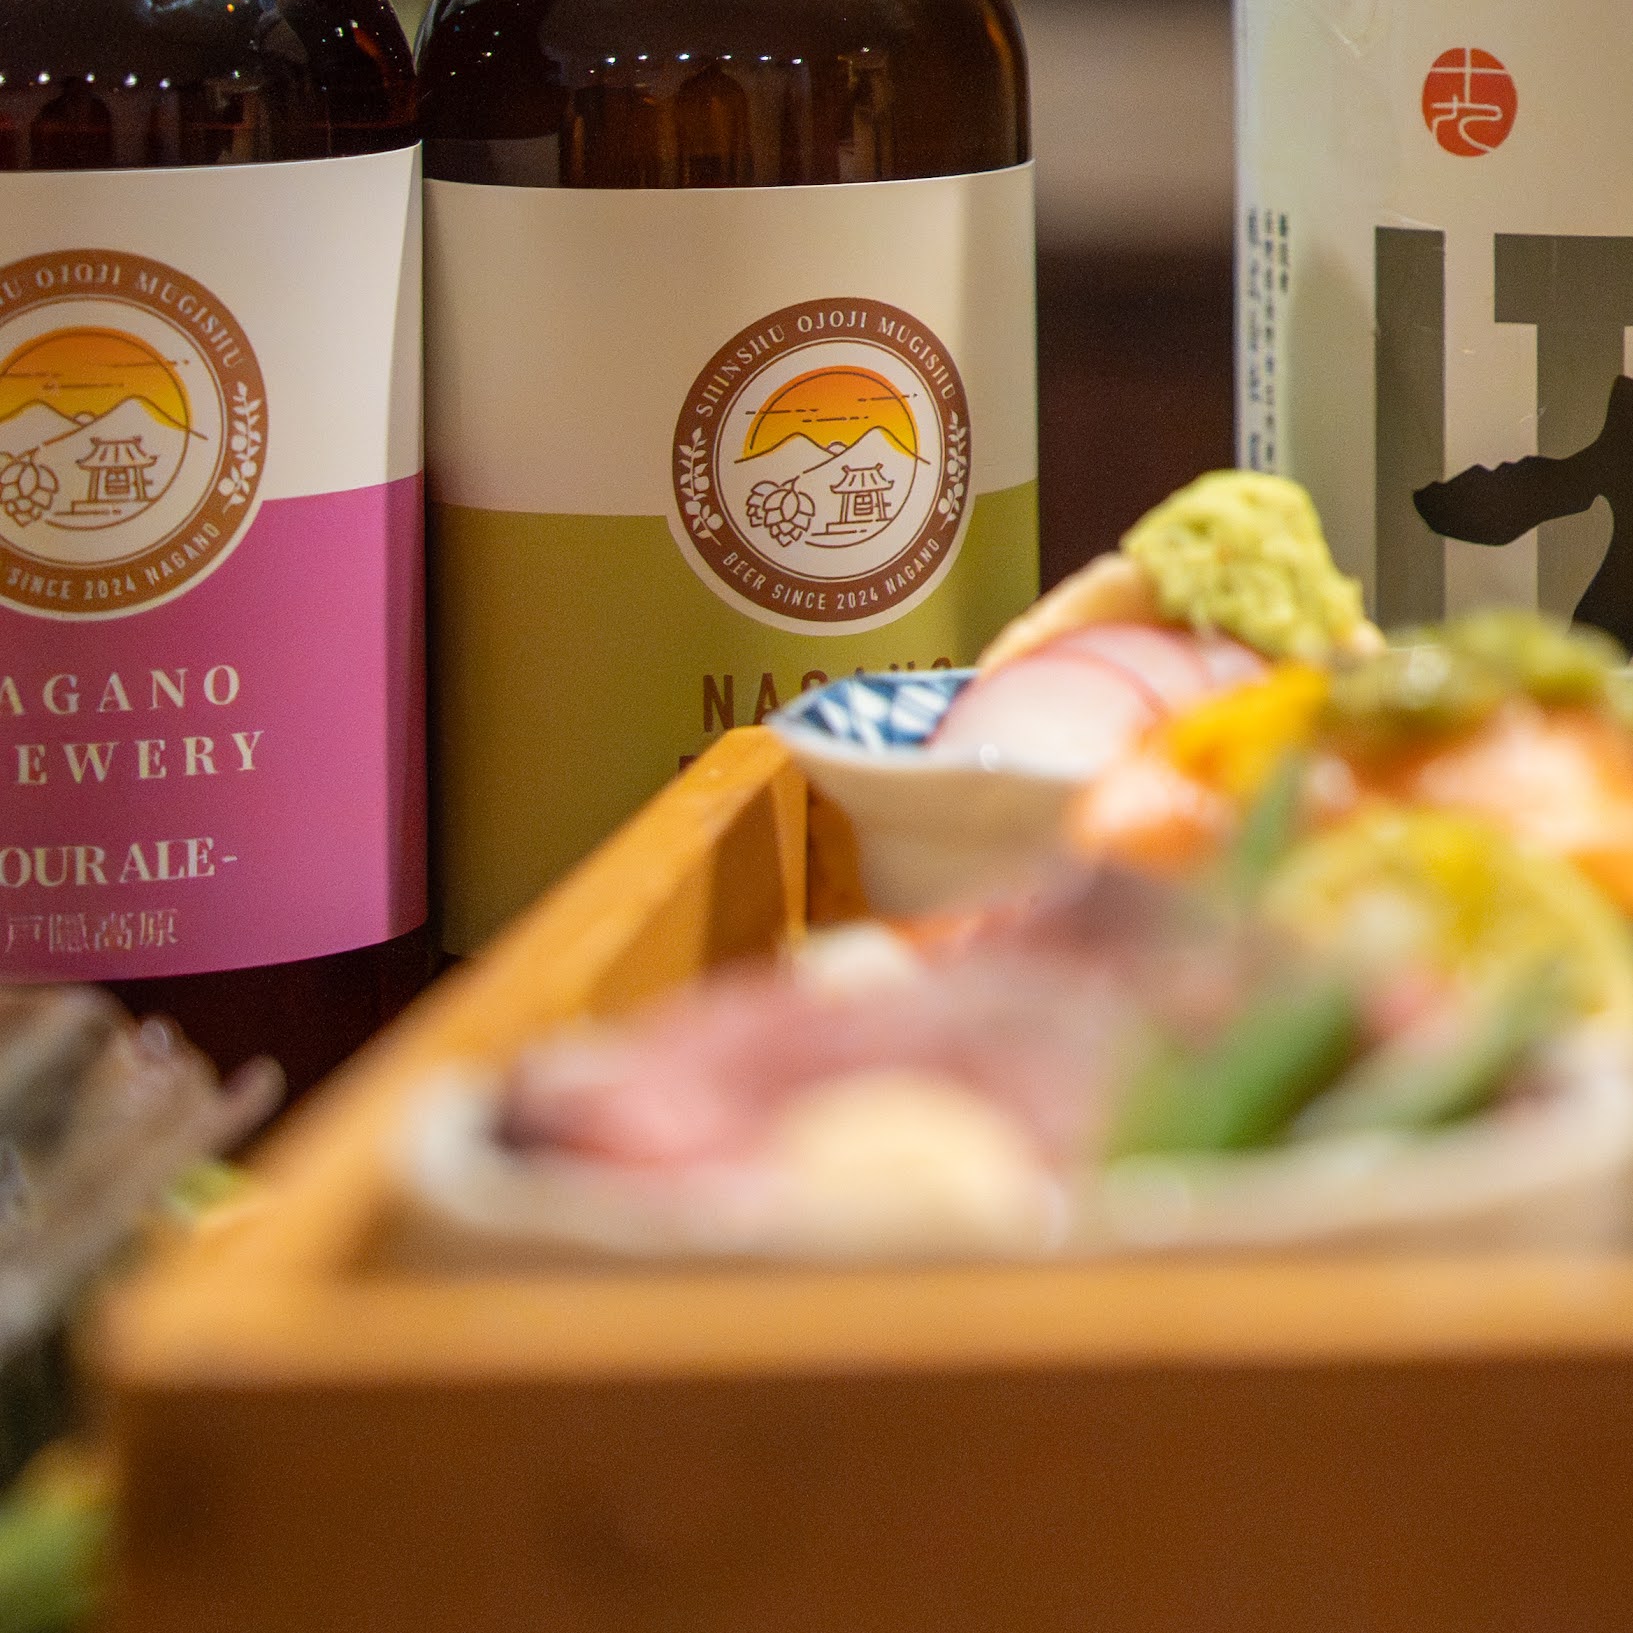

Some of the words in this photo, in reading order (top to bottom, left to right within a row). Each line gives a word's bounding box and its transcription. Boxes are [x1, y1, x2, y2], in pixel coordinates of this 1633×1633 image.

[137, 271, 249, 368] MUGISHU
[695, 324, 787, 418] SHINSHU
[796, 310, 868, 334] OJOJI
[877, 316, 958, 401] MUGISHU
[84, 579, 137, 601] 2024
[147, 520, 222, 587] NAGANO
[722, 551, 767, 592] BEER
[771, 583, 827, 611] SINCE
[837, 588, 880, 610] 2024
[885, 536, 941, 595] NAGANO
